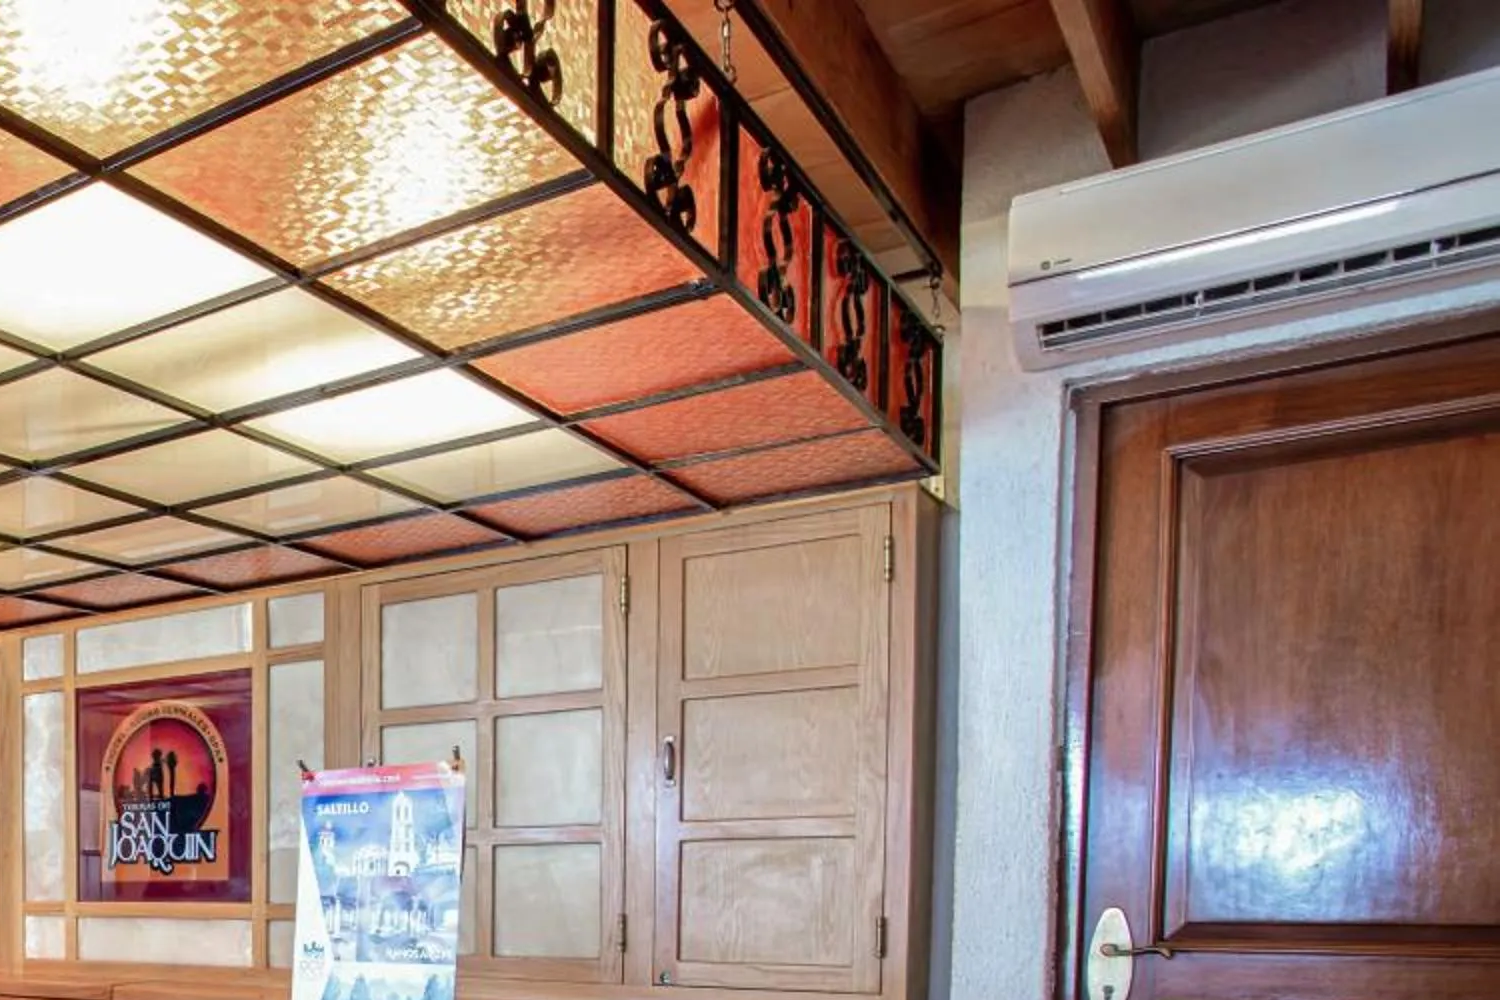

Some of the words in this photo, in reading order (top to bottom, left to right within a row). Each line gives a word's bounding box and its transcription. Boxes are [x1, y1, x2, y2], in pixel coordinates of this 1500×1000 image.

[316, 801, 369, 816] SALTILLO
[120, 811, 171, 839] SAN
[111, 824, 216, 873] JOAQUIN
